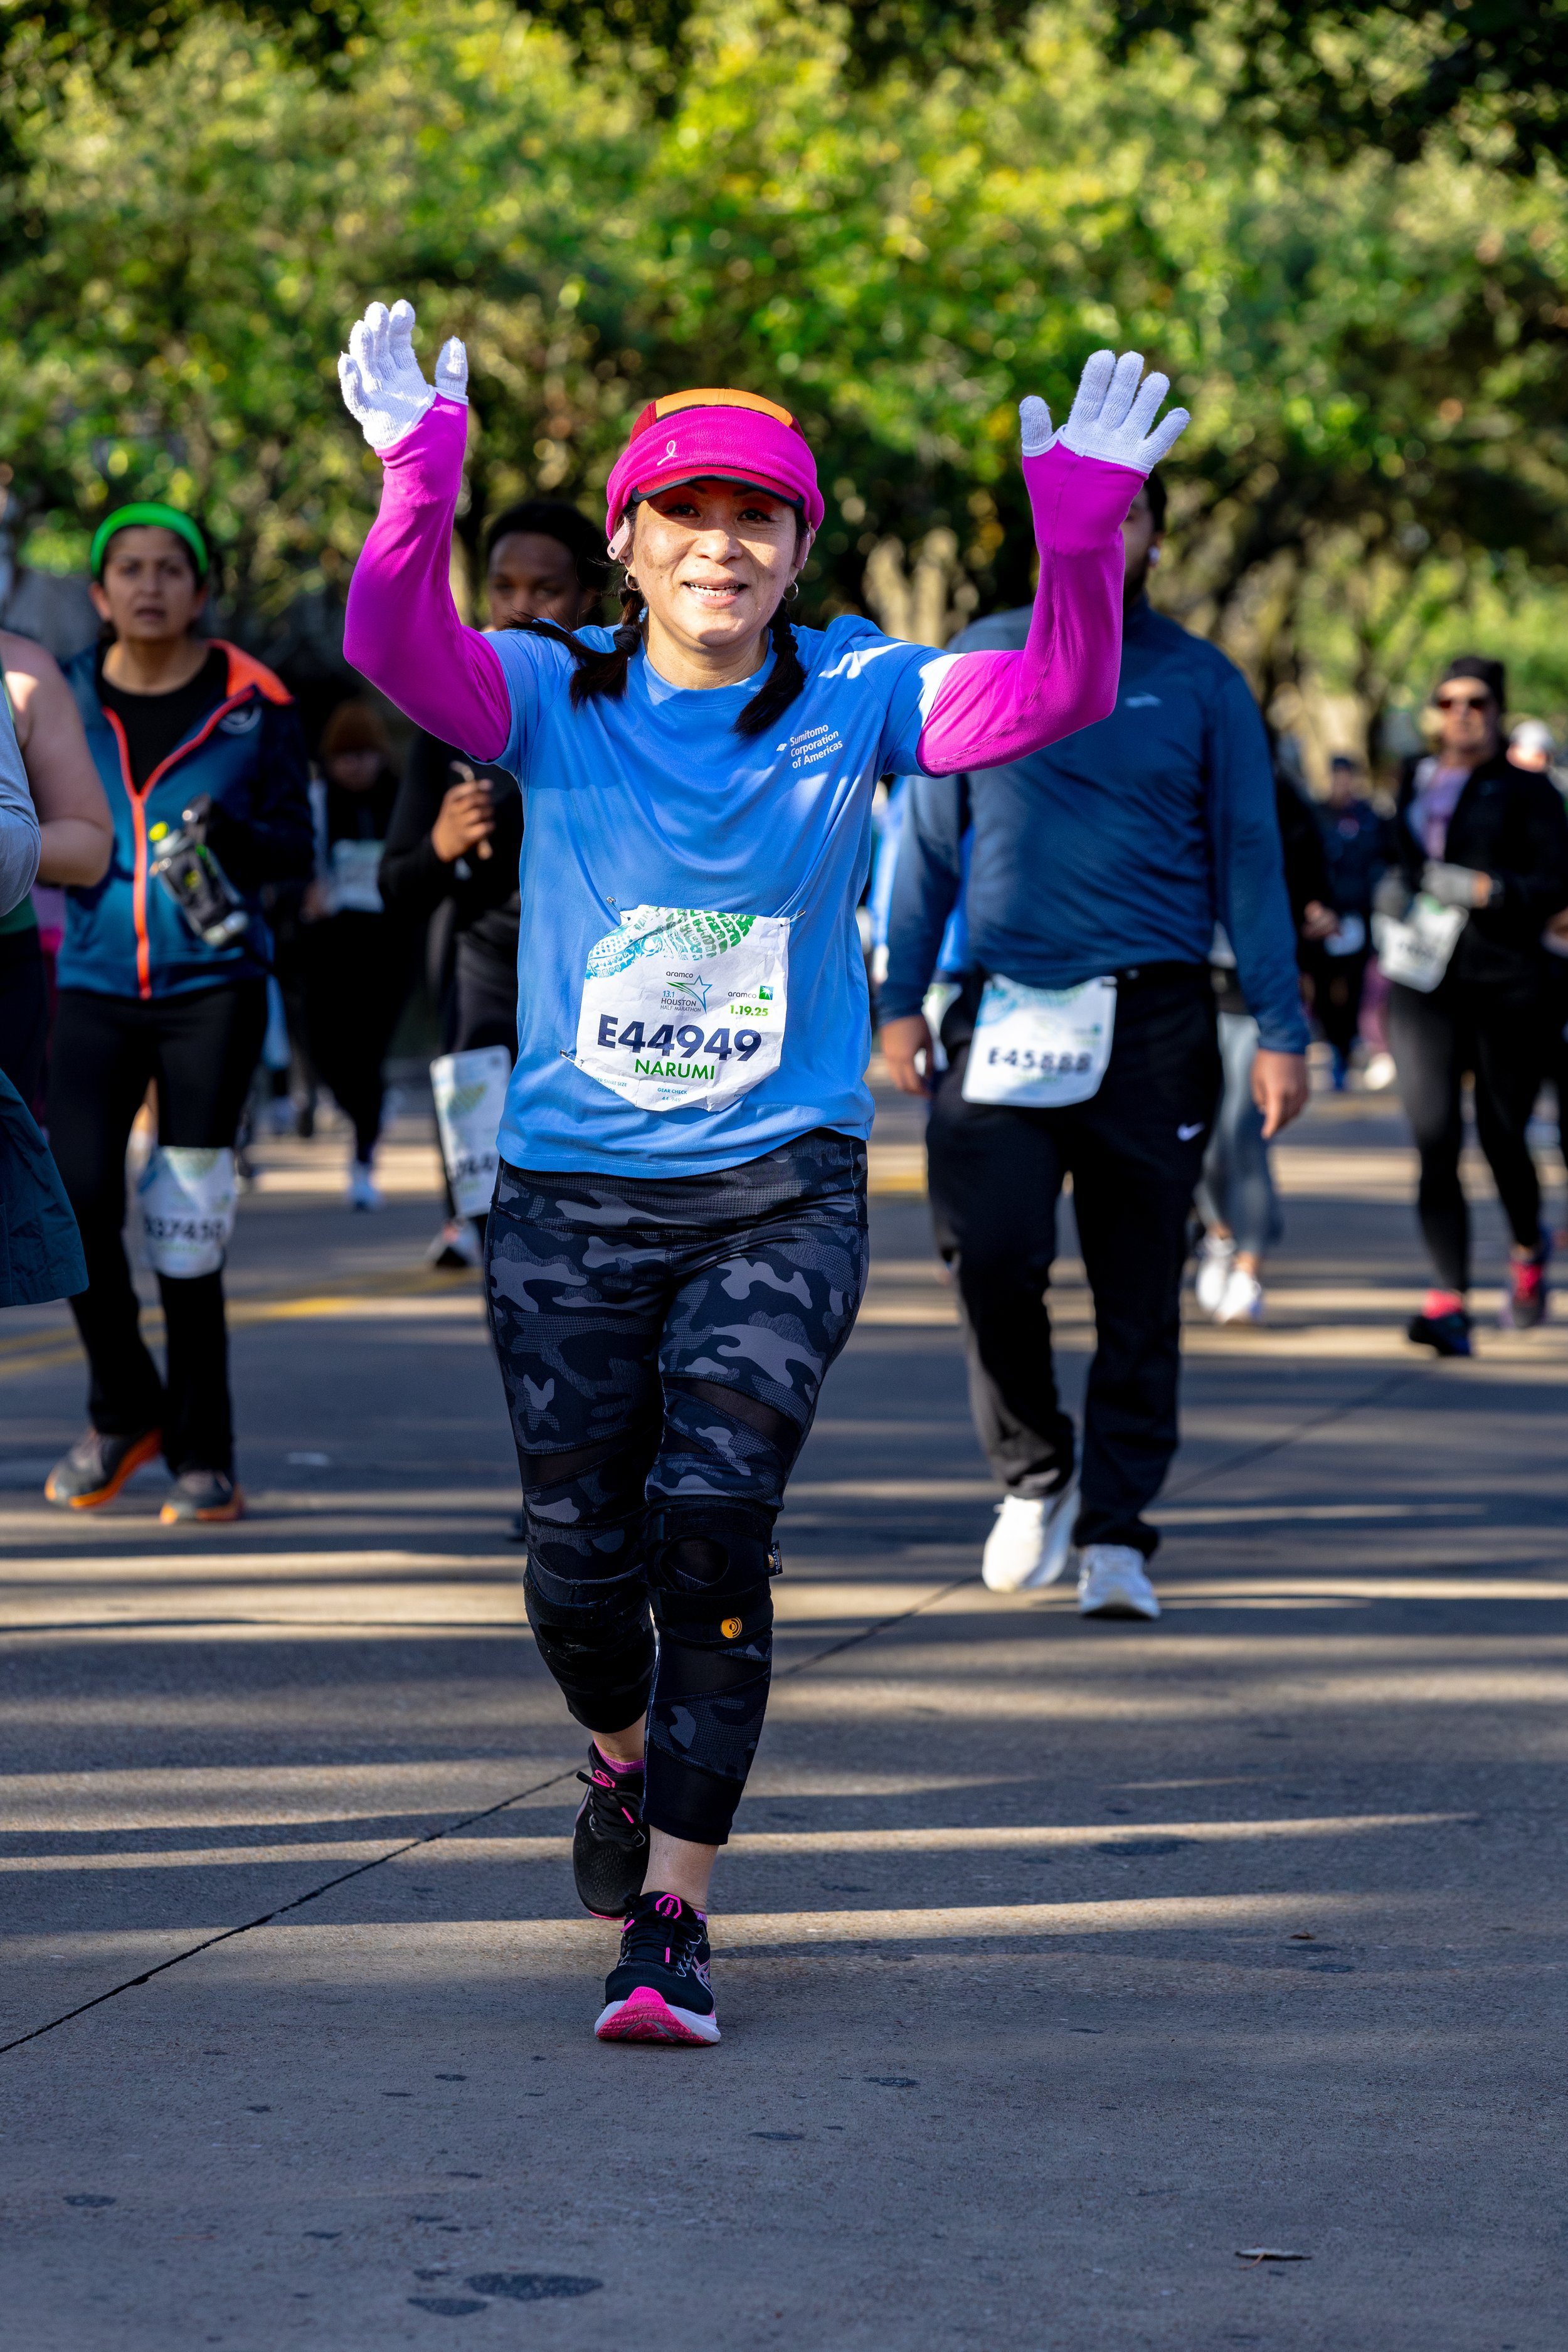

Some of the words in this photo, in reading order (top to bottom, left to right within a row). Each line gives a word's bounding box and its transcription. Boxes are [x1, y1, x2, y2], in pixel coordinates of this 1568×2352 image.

[790, 724, 829, 746] Sumitomo
[791, 731, 839, 757] Corporation
[792, 756, 802, 769] of
[803, 740, 843, 765] Americas
[660, 998, 696, 1007] HOUSTON
[730, 1005, 769, 1017] 1.19.25
[597, 1014, 762, 1062] E44949
[634, 1059, 715, 1080] NARUMI
